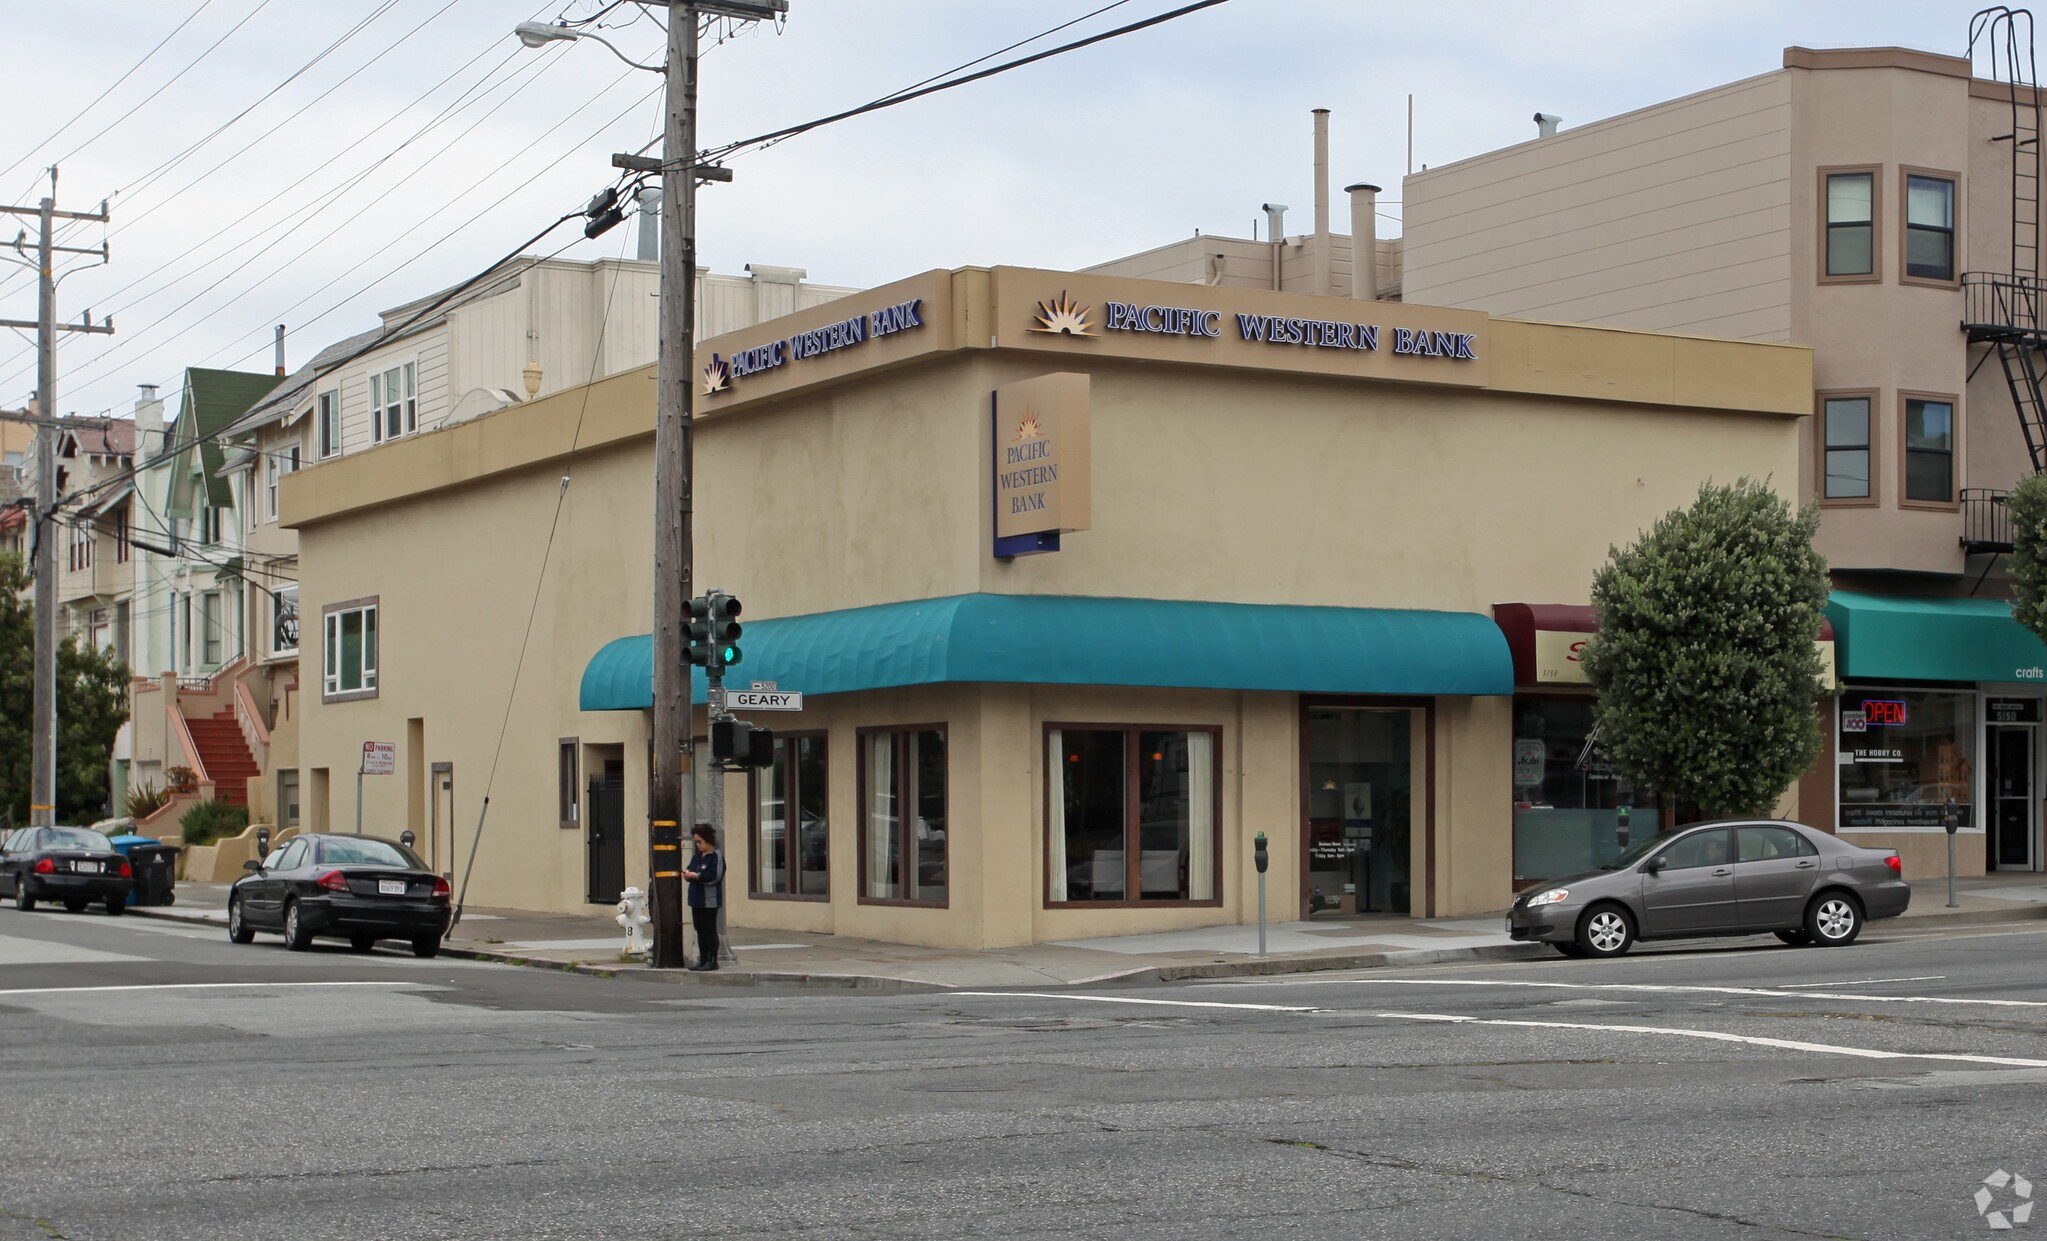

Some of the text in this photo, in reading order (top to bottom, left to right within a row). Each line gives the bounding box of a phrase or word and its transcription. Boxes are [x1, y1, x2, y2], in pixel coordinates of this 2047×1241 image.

[730, 299, 924, 379] PACIFIC WESTERN BANK
[1106, 302, 1478, 360] PACIFIC WESTERN BANK
[1007, 440, 1050, 464] PACIFIC
[1000, 463, 1058, 490] WESTERN
[1011, 492, 1046, 514] BANK
[2015, 666, 2044, 679] crafts
[738, 694, 790, 706] GEARY
[1863, 702, 1905, 724] OPEN
[1855, 749, 1867, 757] THE
[1869, 749, 1890, 757] HOBBY
[1866, 808, 1883, 816] beads
[1170, 967, 1216, 979] GEARY
